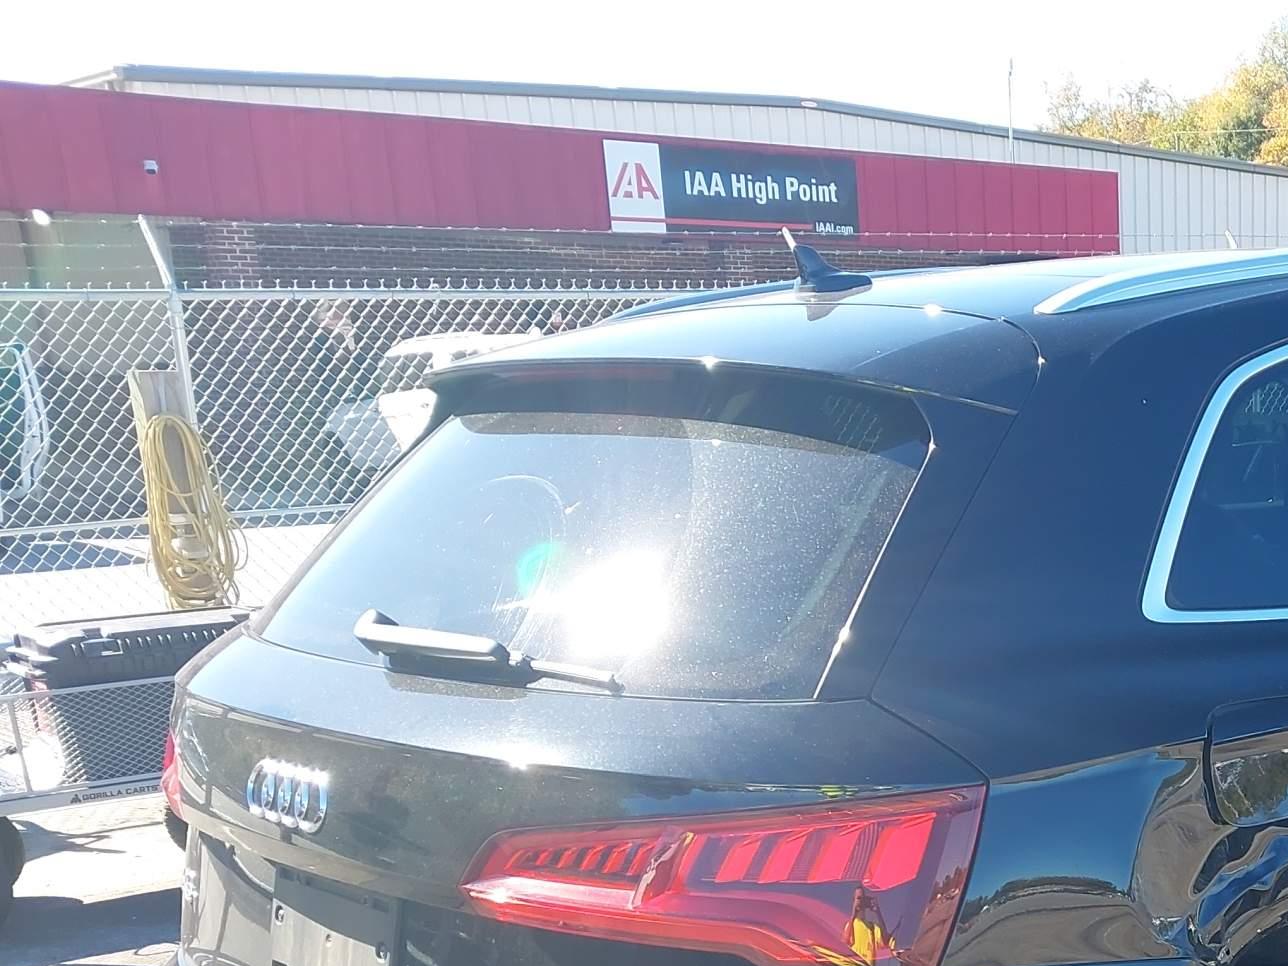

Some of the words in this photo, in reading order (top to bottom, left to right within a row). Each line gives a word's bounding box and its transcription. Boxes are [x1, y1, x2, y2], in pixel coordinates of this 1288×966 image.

[684, 170, 726, 197] IAA
[731, 173, 780, 205] High
[785, 176, 838, 203] Point
[82, 789, 123, 801] GORILLA
[125, 784, 159, 795] CARTS
